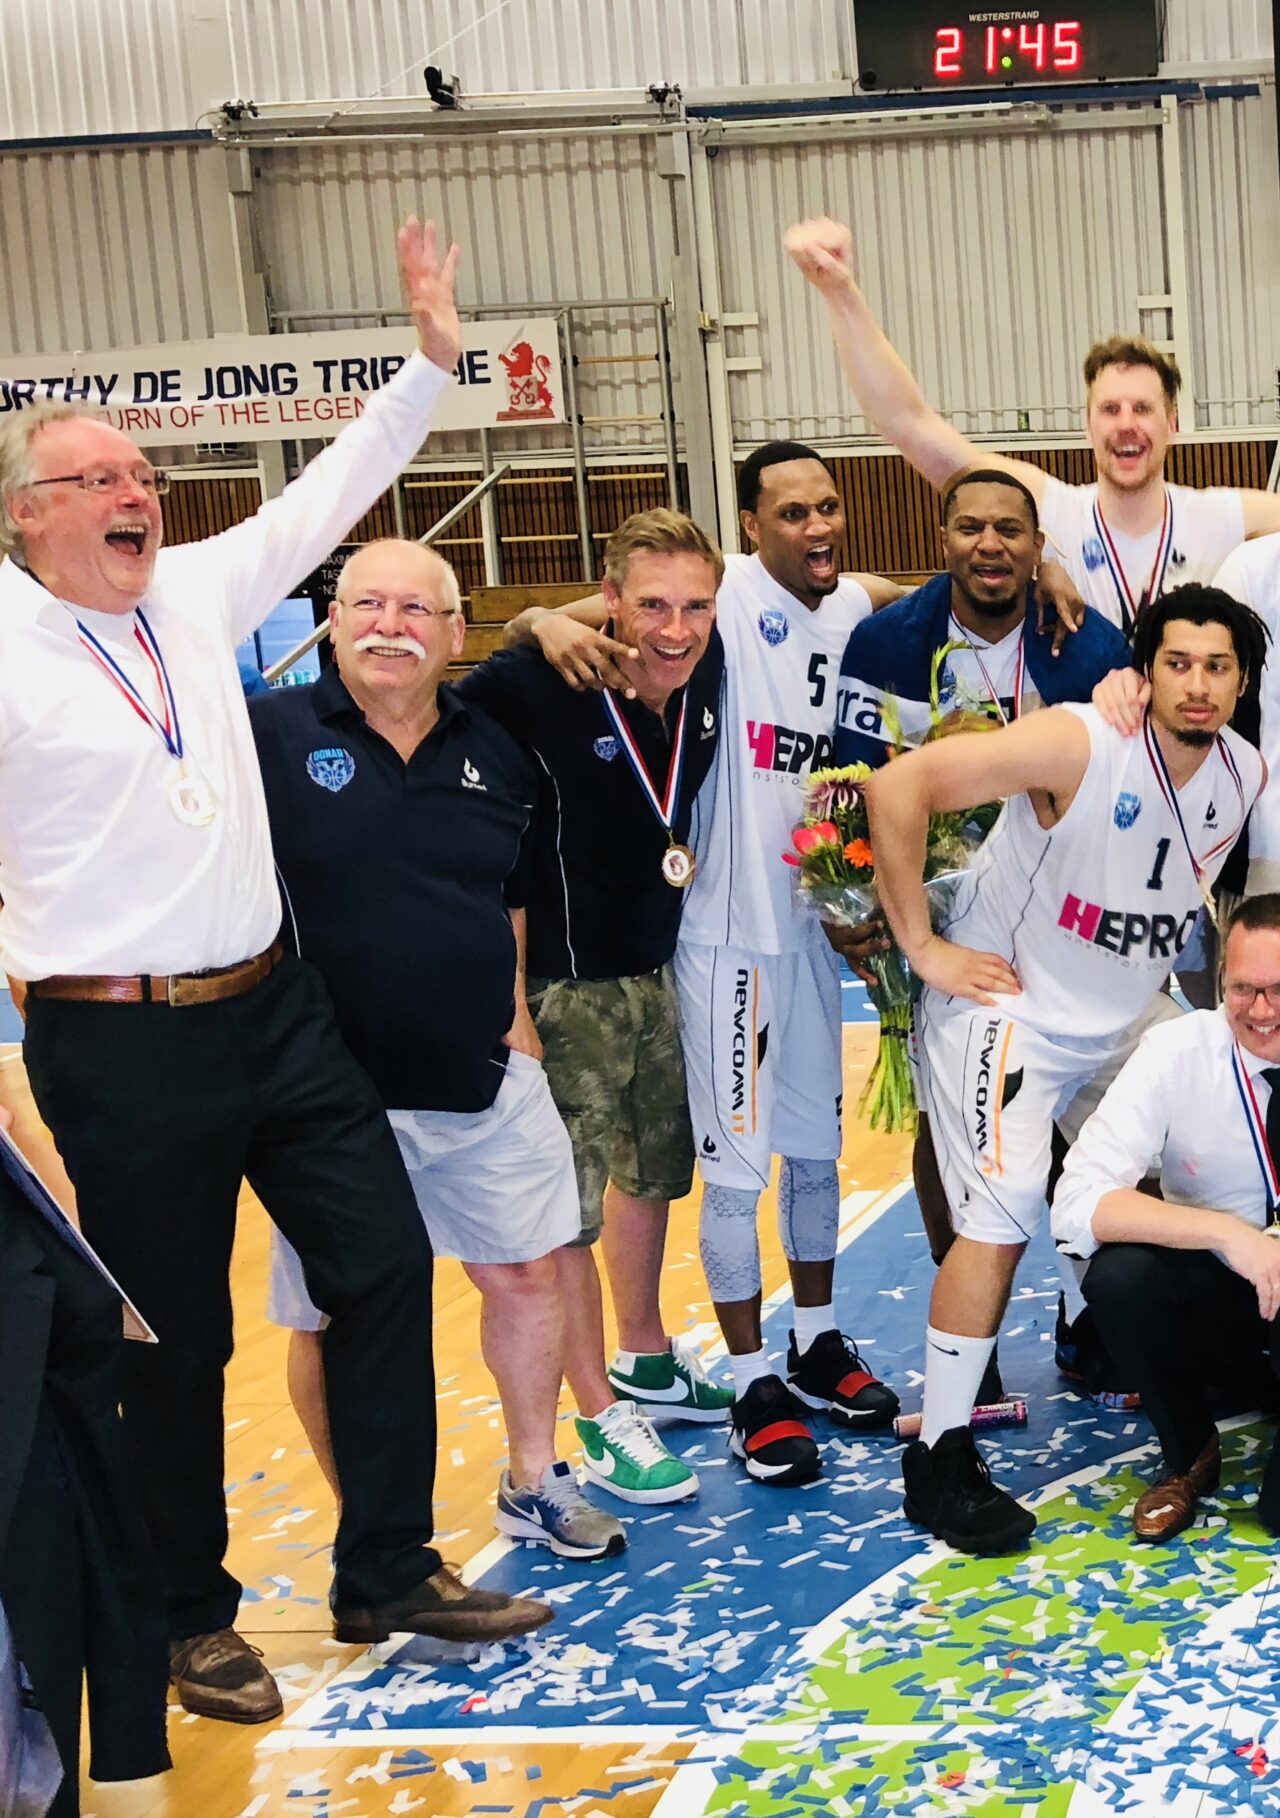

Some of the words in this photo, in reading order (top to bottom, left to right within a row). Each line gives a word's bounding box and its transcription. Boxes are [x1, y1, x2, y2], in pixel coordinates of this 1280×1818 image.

[968, 10, 1040, 22] WESTERSTRAND
[935, 21, 1081, 76] 21:45
[132, 369, 181, 404] DE
[197, 362, 299, 400] JONG
[313, 350, 492, 394] TRIBE
[170, 405, 205, 428] OF
[214, 401, 271, 426] THE
[278, 396, 367, 423] LEGEN
[807, 652, 828, 708] 5
[746, 719, 837, 775] HEPR
[1146, 837, 1171, 891] 1
[731, 1114, 745, 1136] IT
